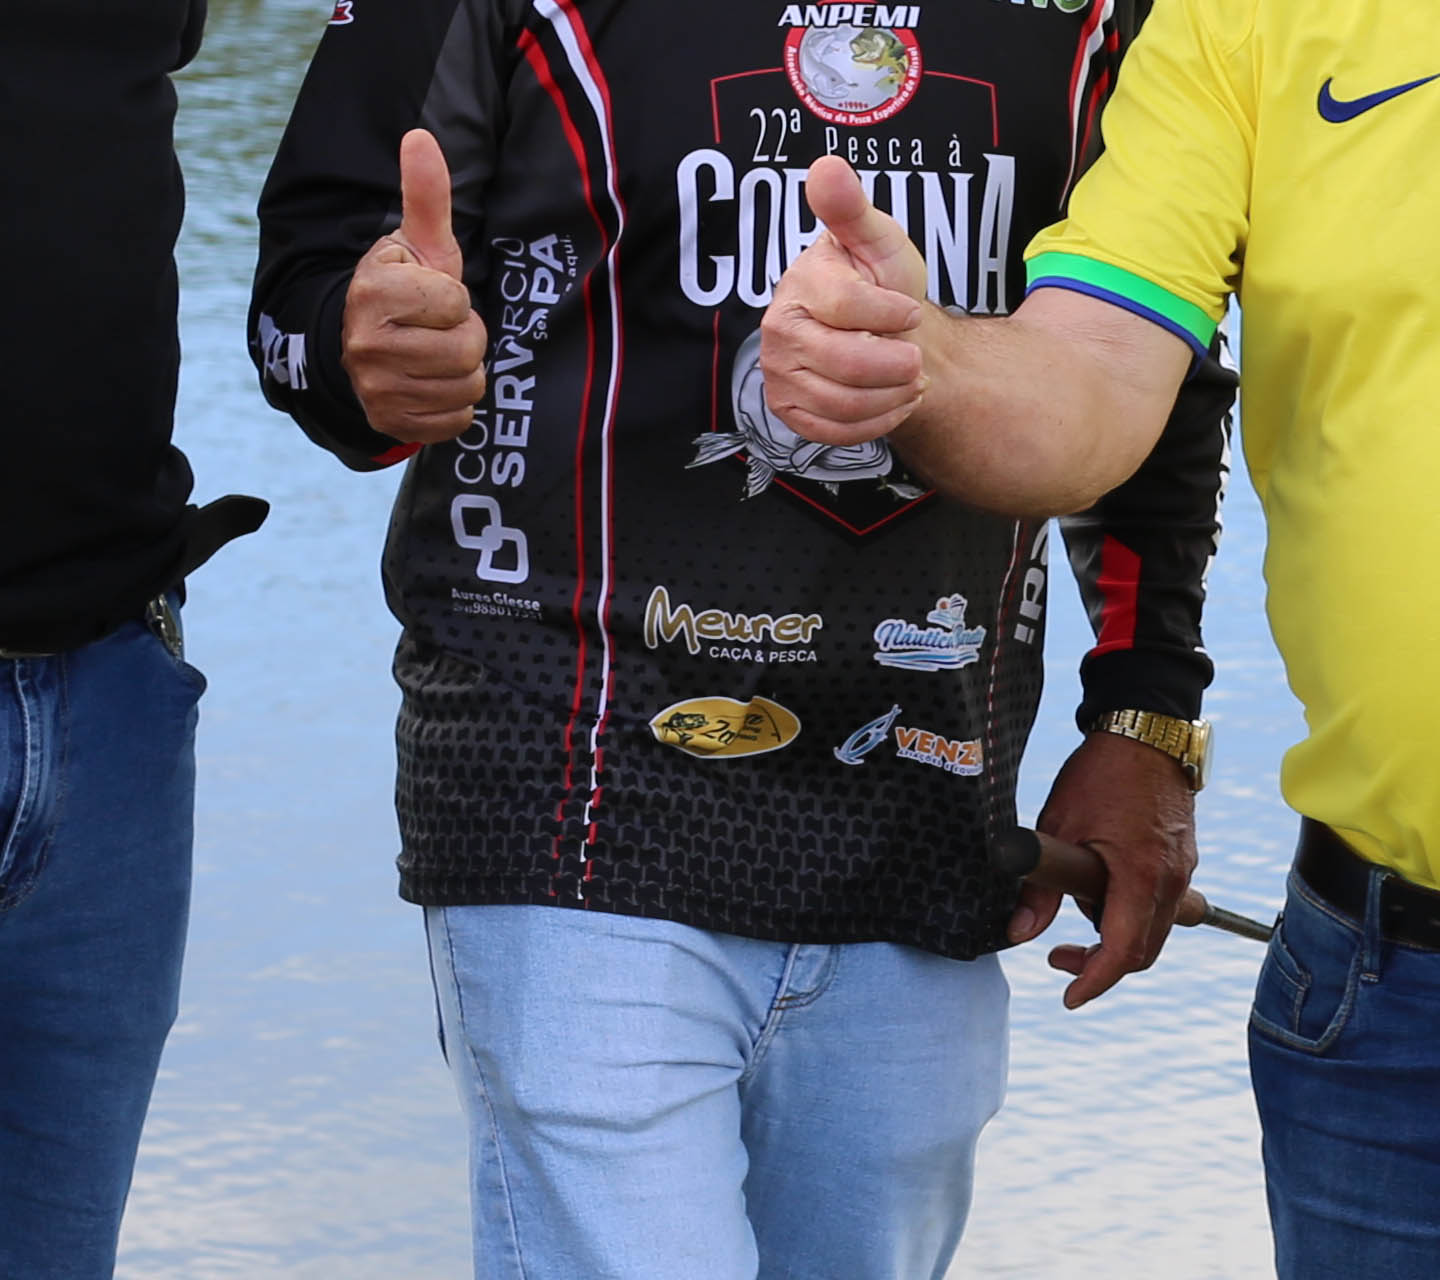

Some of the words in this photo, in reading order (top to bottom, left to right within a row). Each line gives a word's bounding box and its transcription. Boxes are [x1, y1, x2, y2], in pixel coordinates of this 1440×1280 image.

[778, 4, 921, 29] ANPEMI
[750, 107, 801, 163] 22ª
[825, 126, 924, 167] Pesca
[948, 133, 962, 167] à
[644, 585, 823, 655] Meurer
[709, 646, 753, 661] CAÇA
[754, 650, 764, 663] &
[768, 650, 818, 663] PESCA
